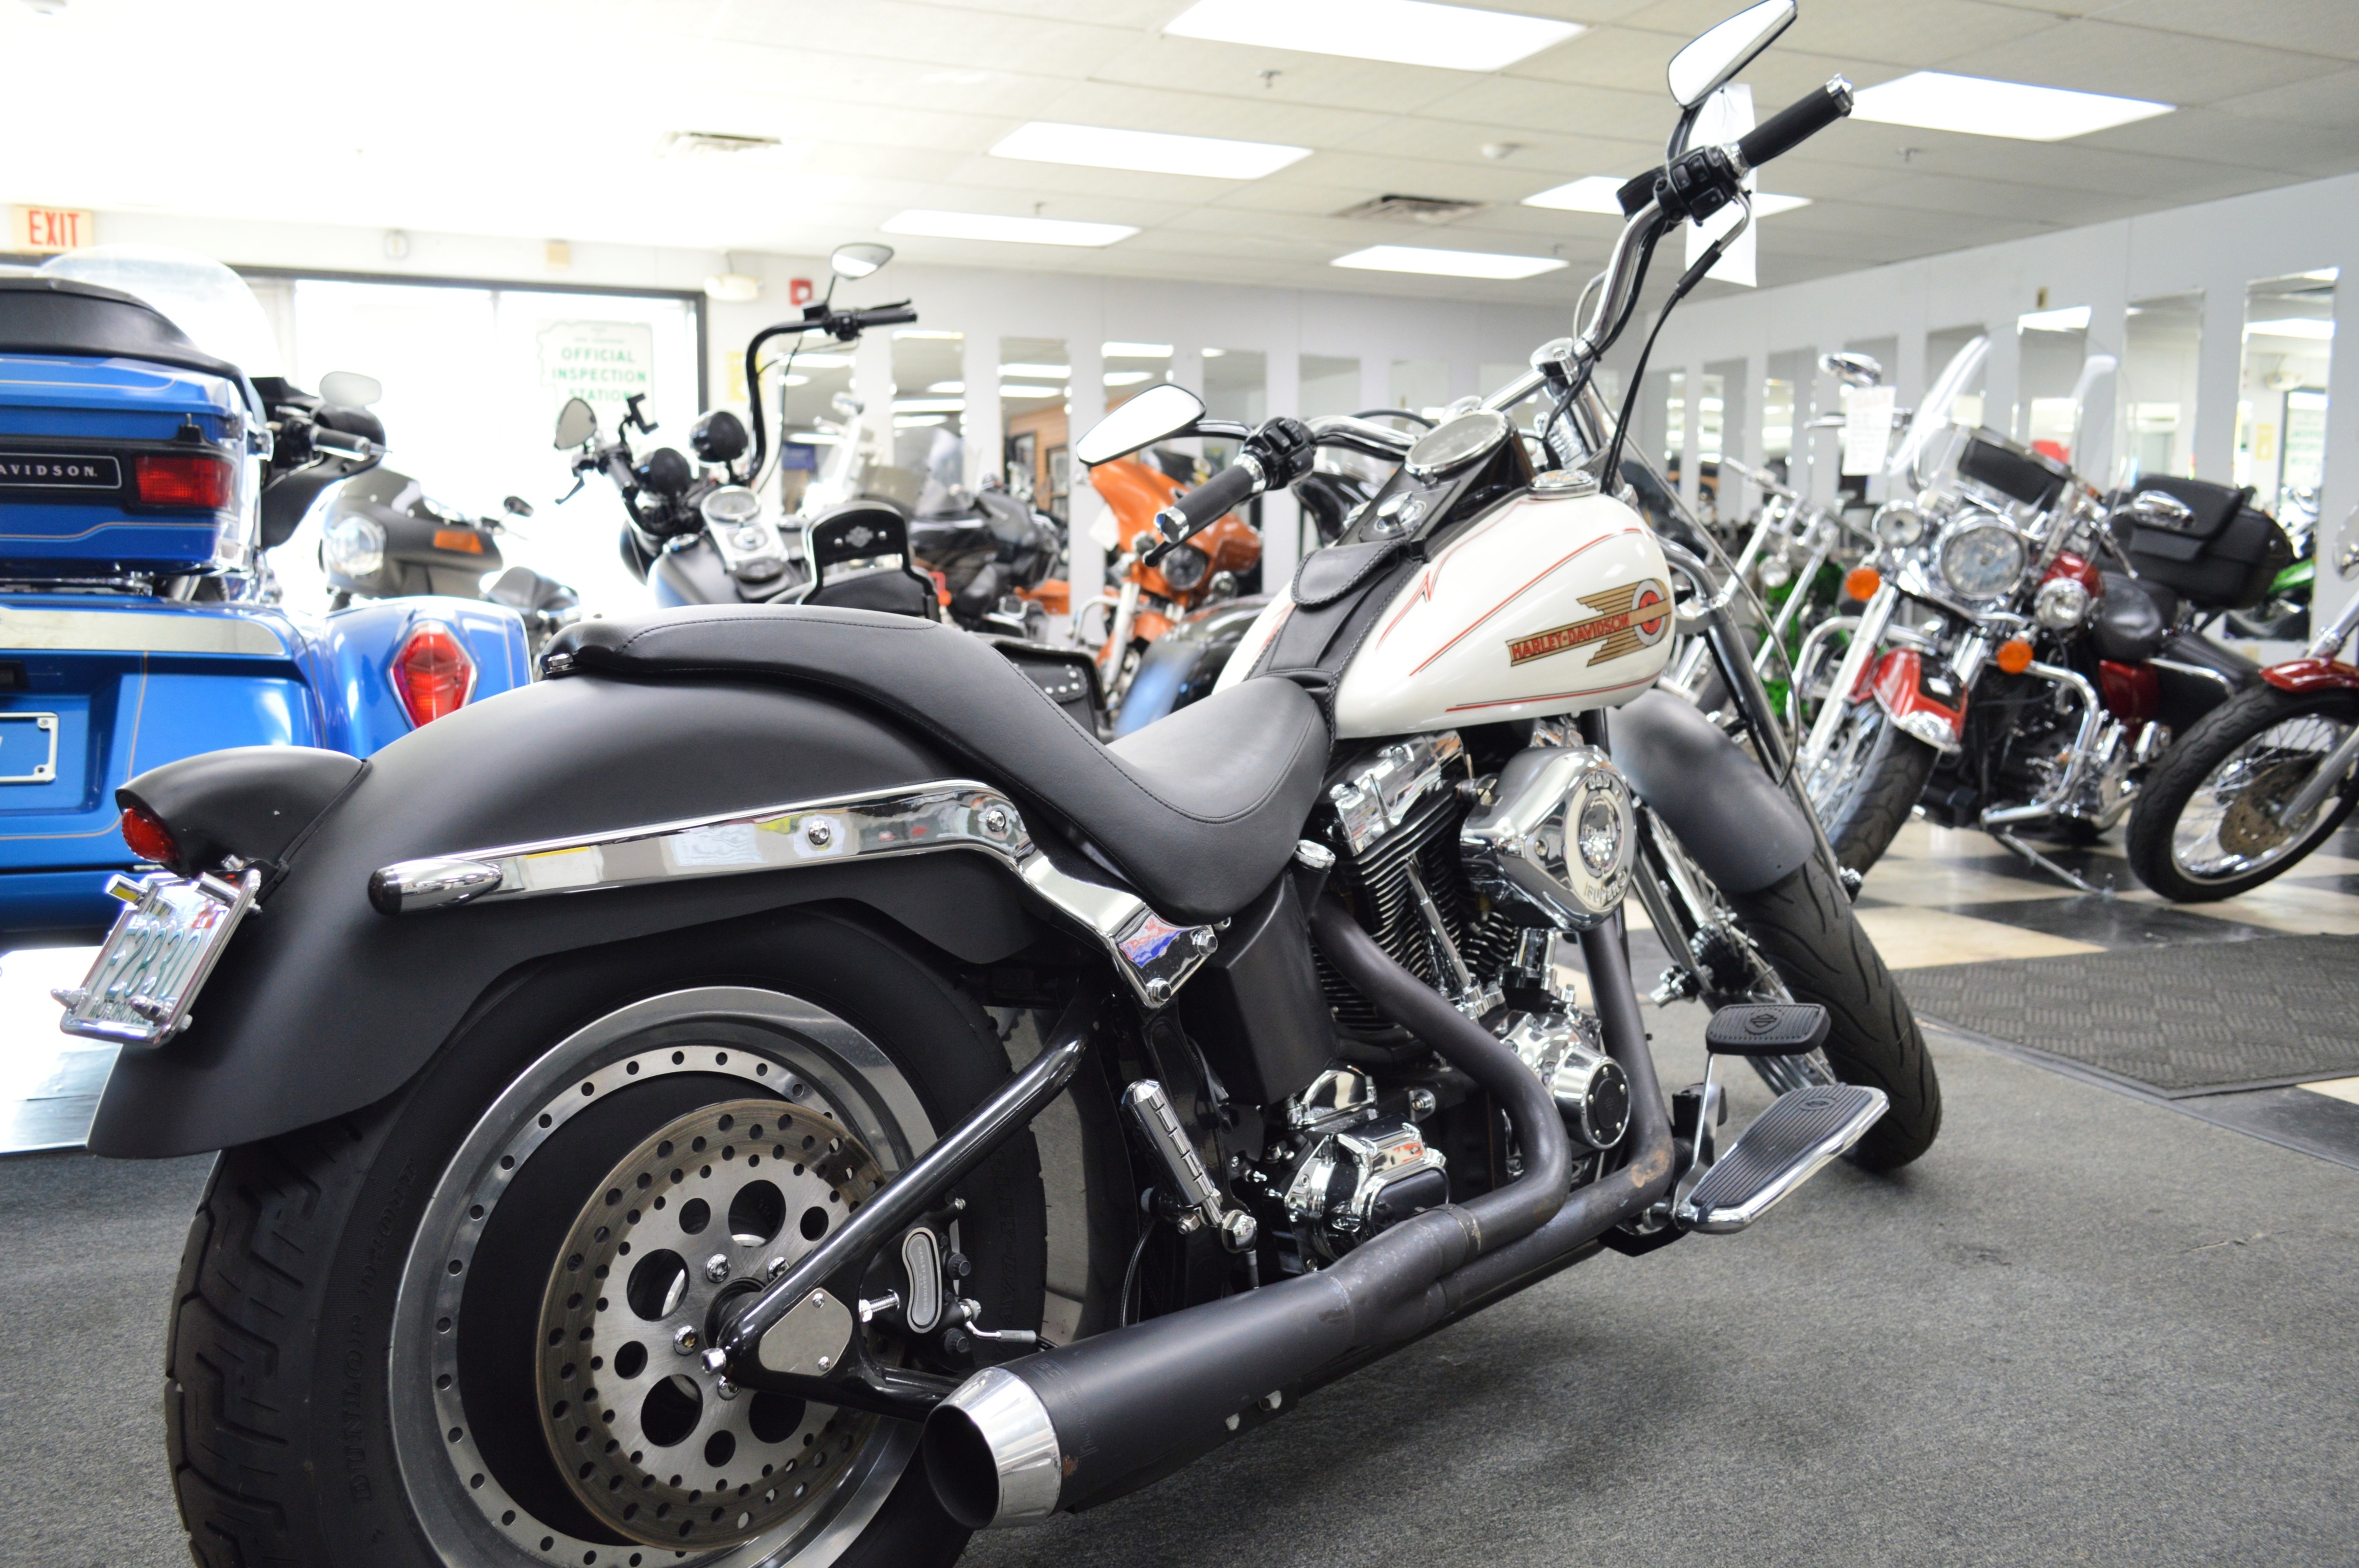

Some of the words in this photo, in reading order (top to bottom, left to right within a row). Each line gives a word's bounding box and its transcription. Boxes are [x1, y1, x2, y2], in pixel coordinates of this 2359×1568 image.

[28, 210, 80, 247] EXIT
[552, 367, 646, 383] INSPECTION
[561, 347, 636, 363] OFFICIAL
[1511, 613, 1630, 660] HARLEY-DAVIDSON
[917, 1246, 928, 1312] HARLEY-DAVIDSON
[342, 1315, 373, 1502] DUNLOP
